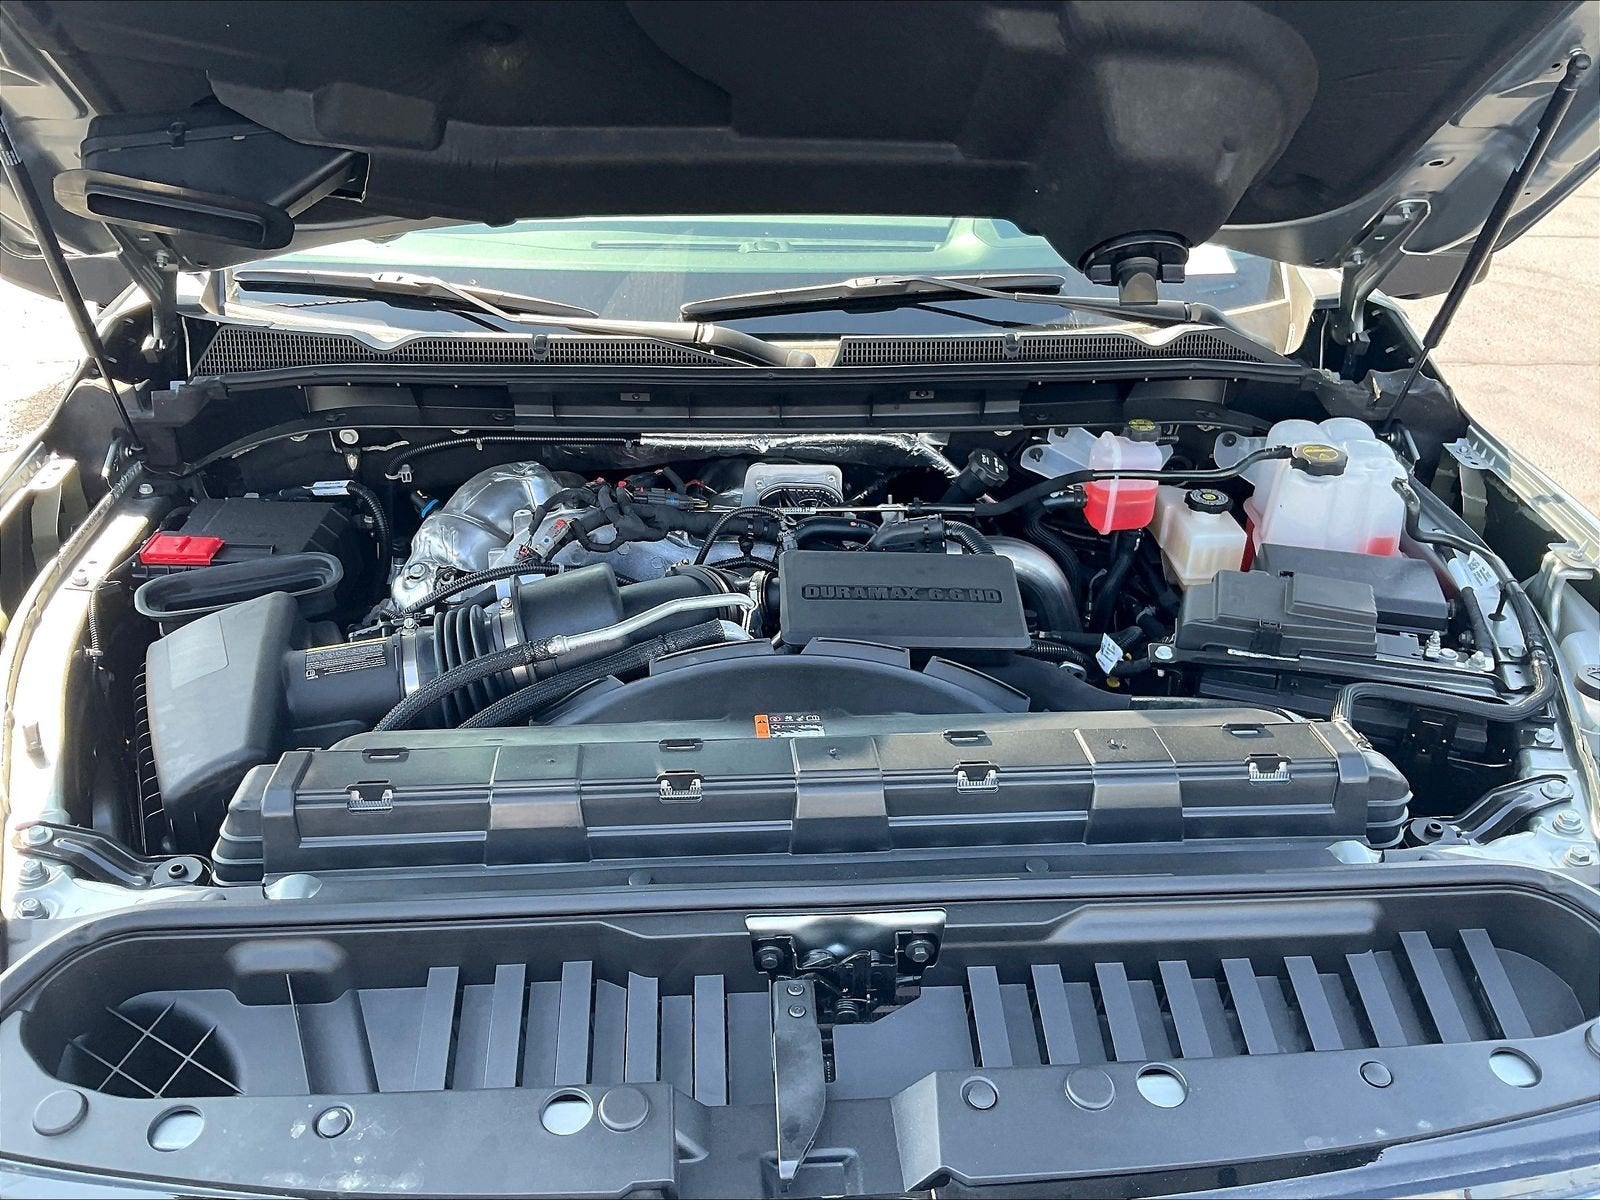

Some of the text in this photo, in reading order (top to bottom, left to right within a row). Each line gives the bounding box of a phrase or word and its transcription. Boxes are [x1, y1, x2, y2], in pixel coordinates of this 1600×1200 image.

[804, 586, 1000, 602] DURAMAX 6.6 HD
